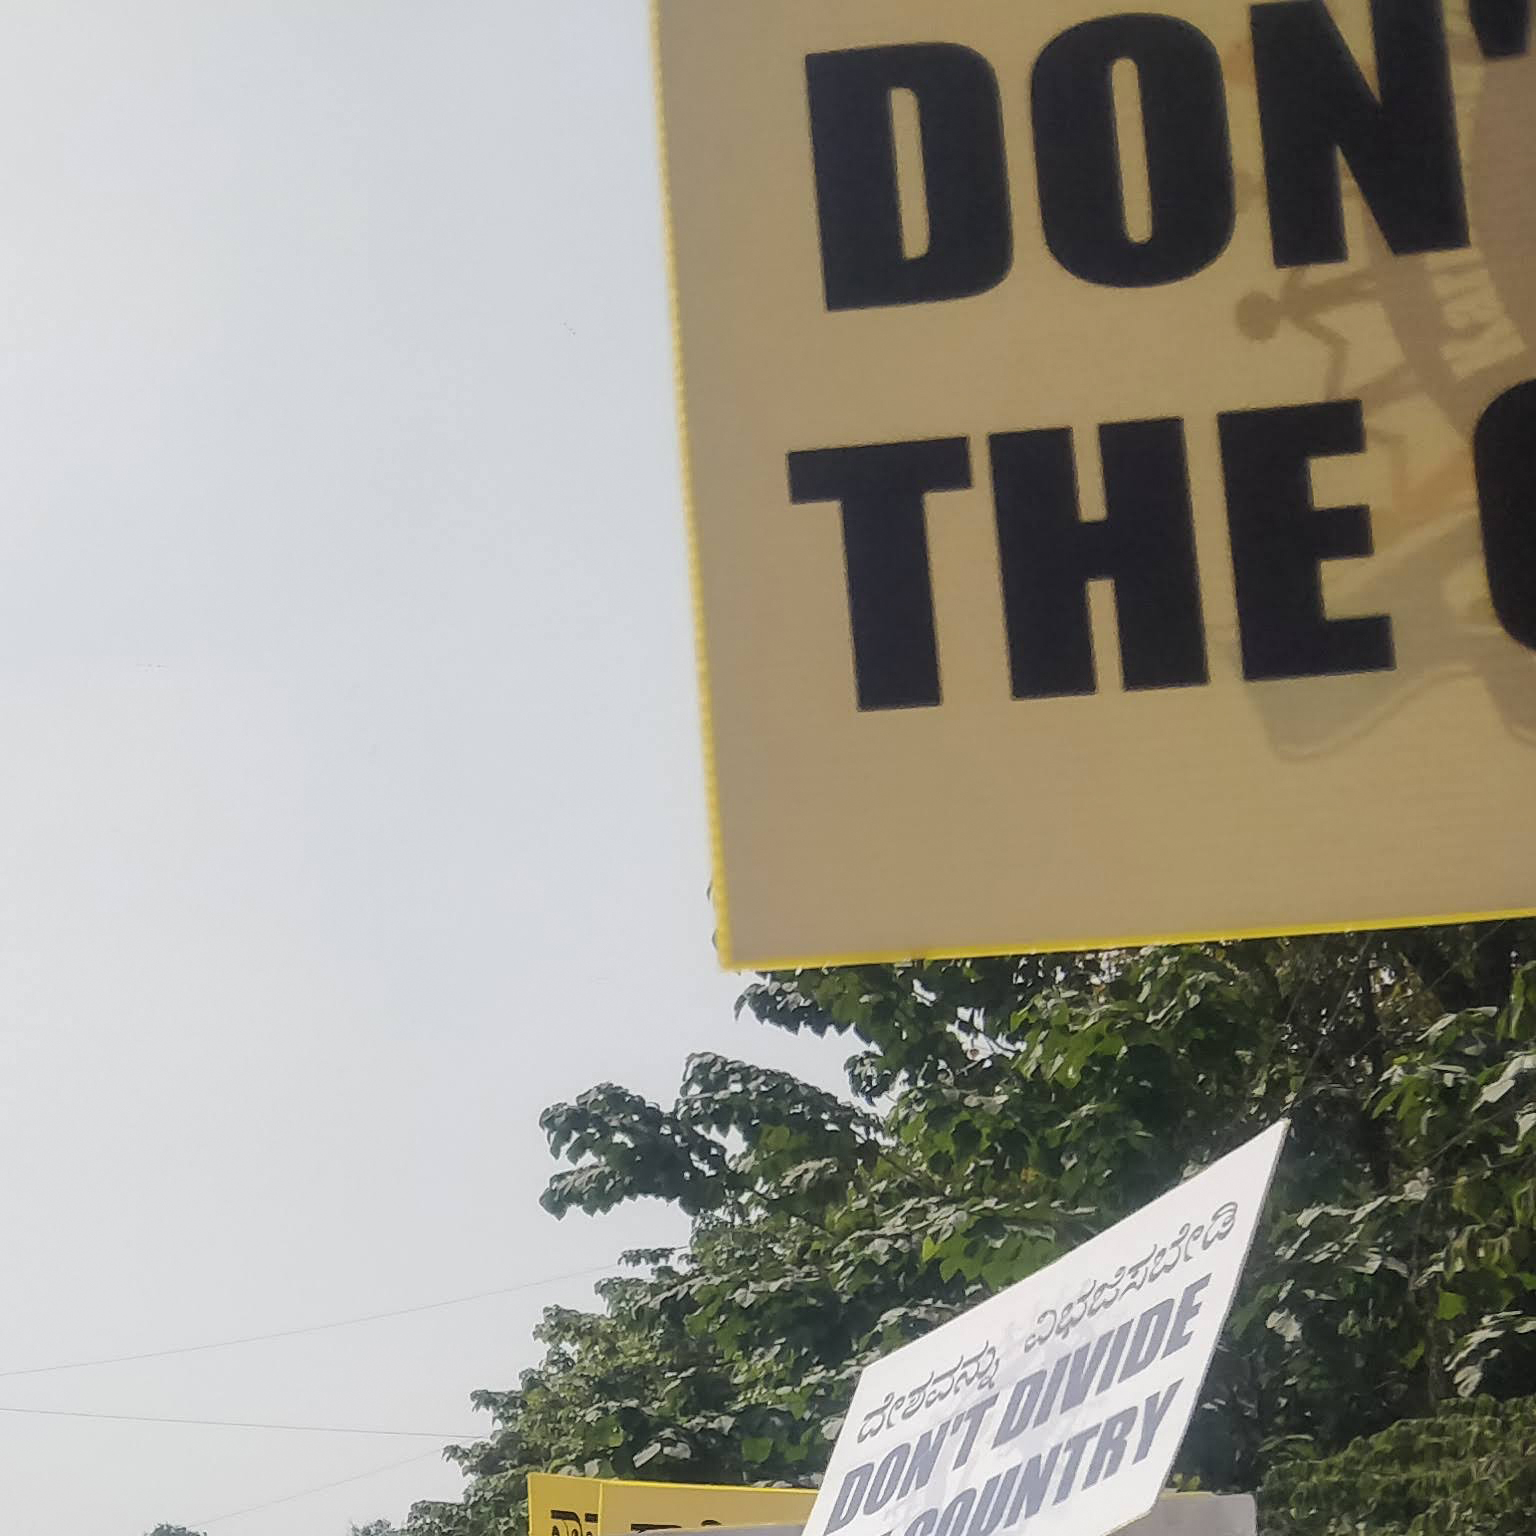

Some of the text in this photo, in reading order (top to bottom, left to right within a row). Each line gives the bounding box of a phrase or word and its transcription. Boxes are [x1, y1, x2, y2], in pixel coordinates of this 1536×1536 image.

[804, 0, 1530, 311] DON'
[786, 399, 1396, 712] THE
[857, 1201, 1238, 1444] ದೇಶವನ್ನು ವಿಭಜಿಸಬೇಡಿ
[993, 1274, 1213, 1444] DIVIDE
